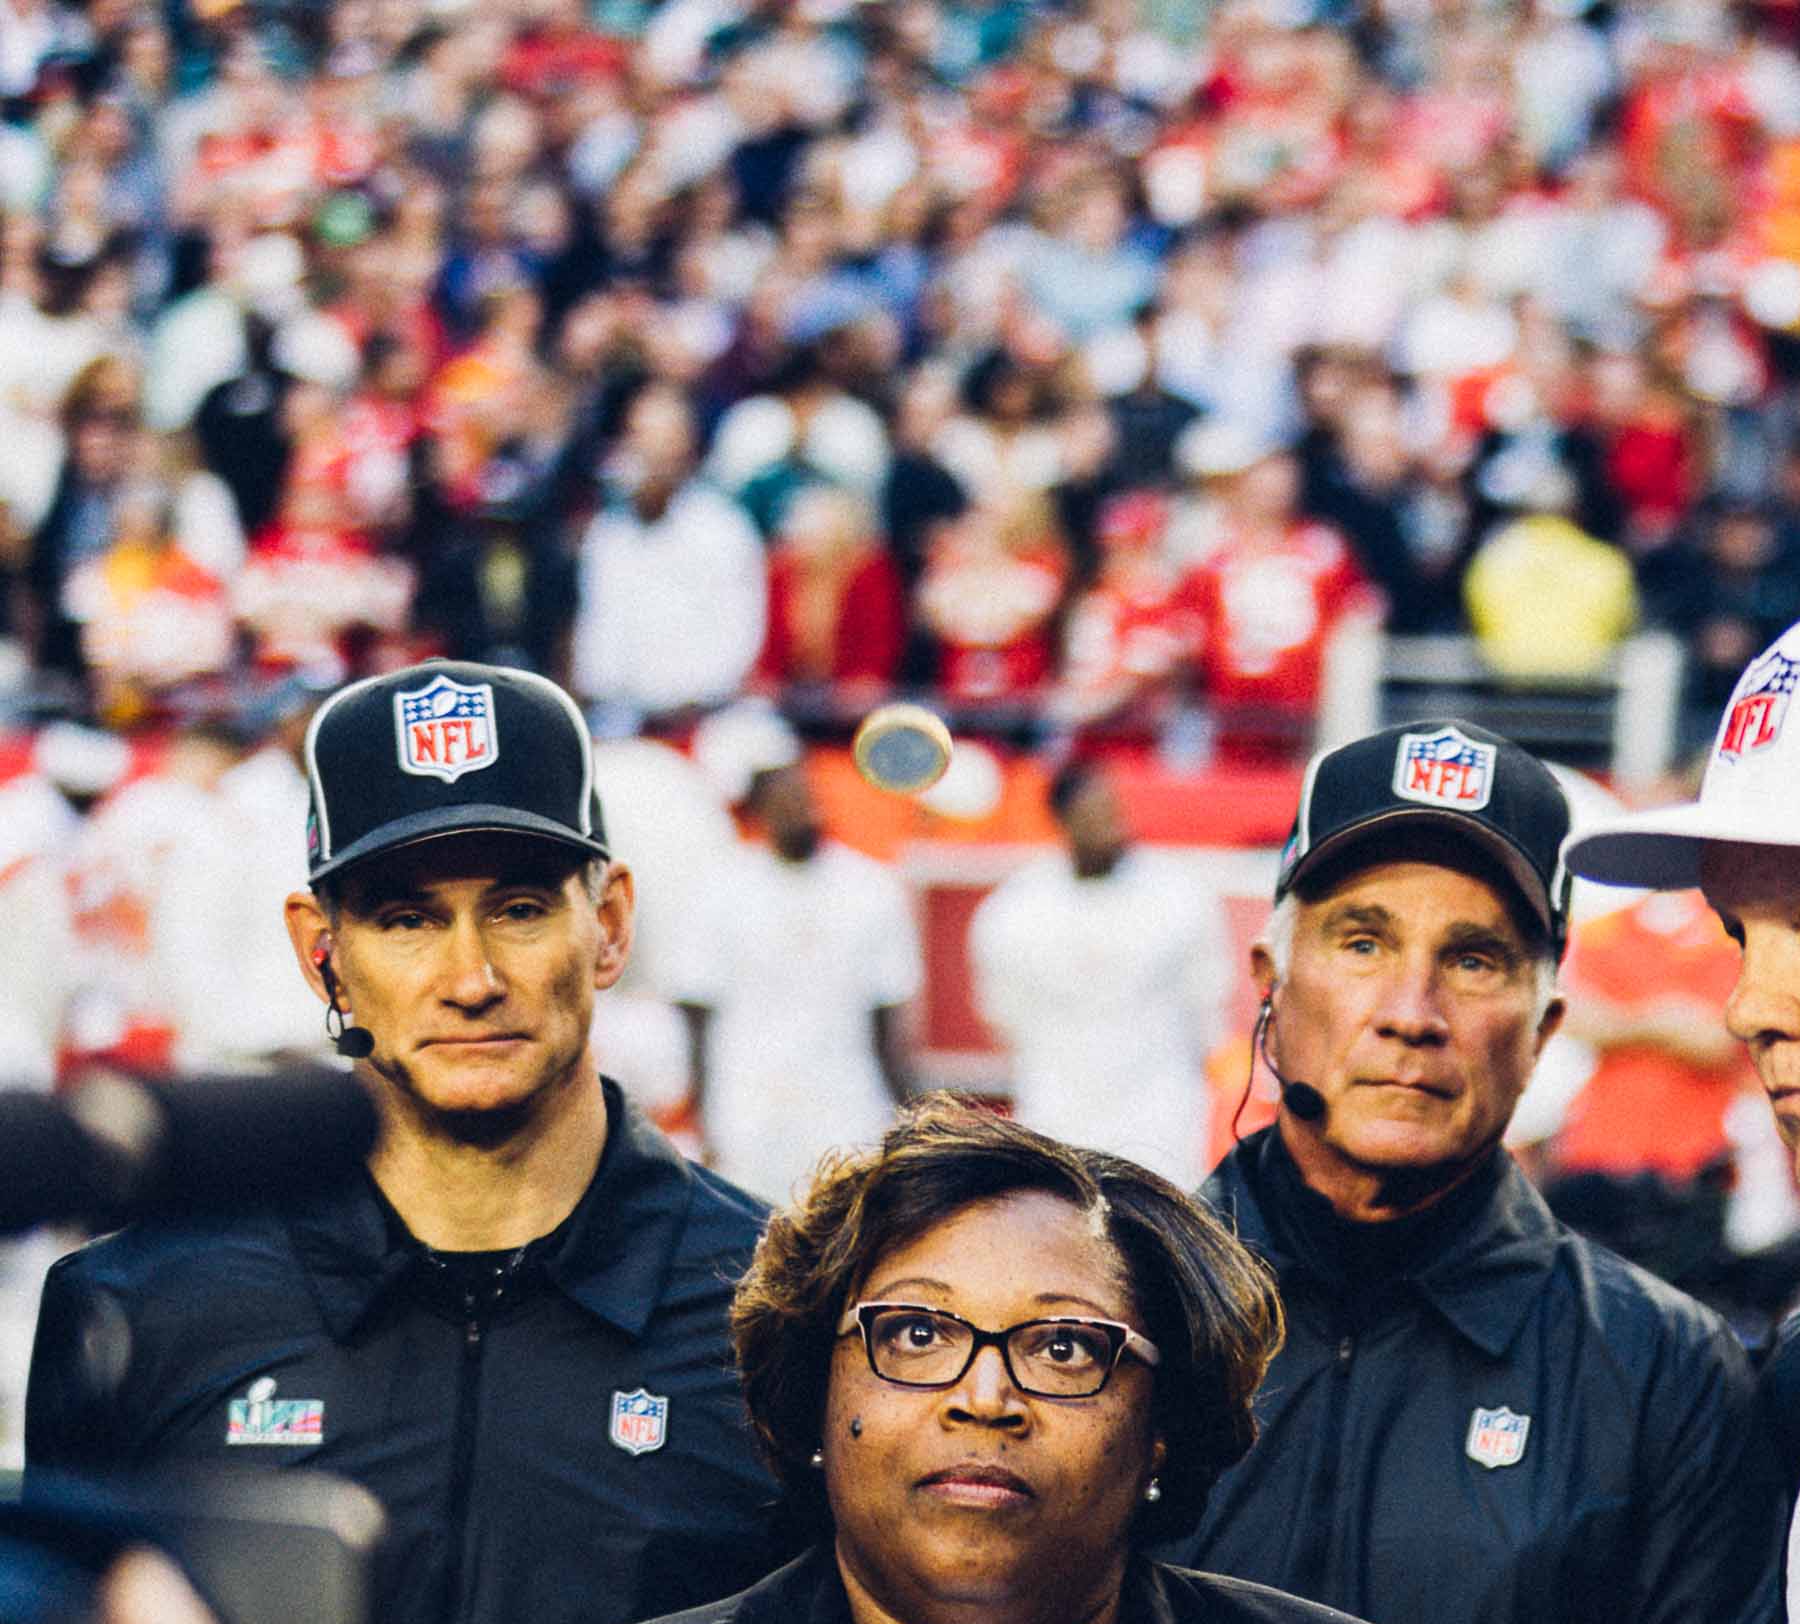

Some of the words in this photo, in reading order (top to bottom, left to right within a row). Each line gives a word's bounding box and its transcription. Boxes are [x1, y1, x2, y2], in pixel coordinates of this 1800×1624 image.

[412, 719, 486, 764] NFL
[1721, 697, 1776, 754] NFL
[1409, 757, 1478, 799] NFL
[620, 1414, 657, 1441] NFL
